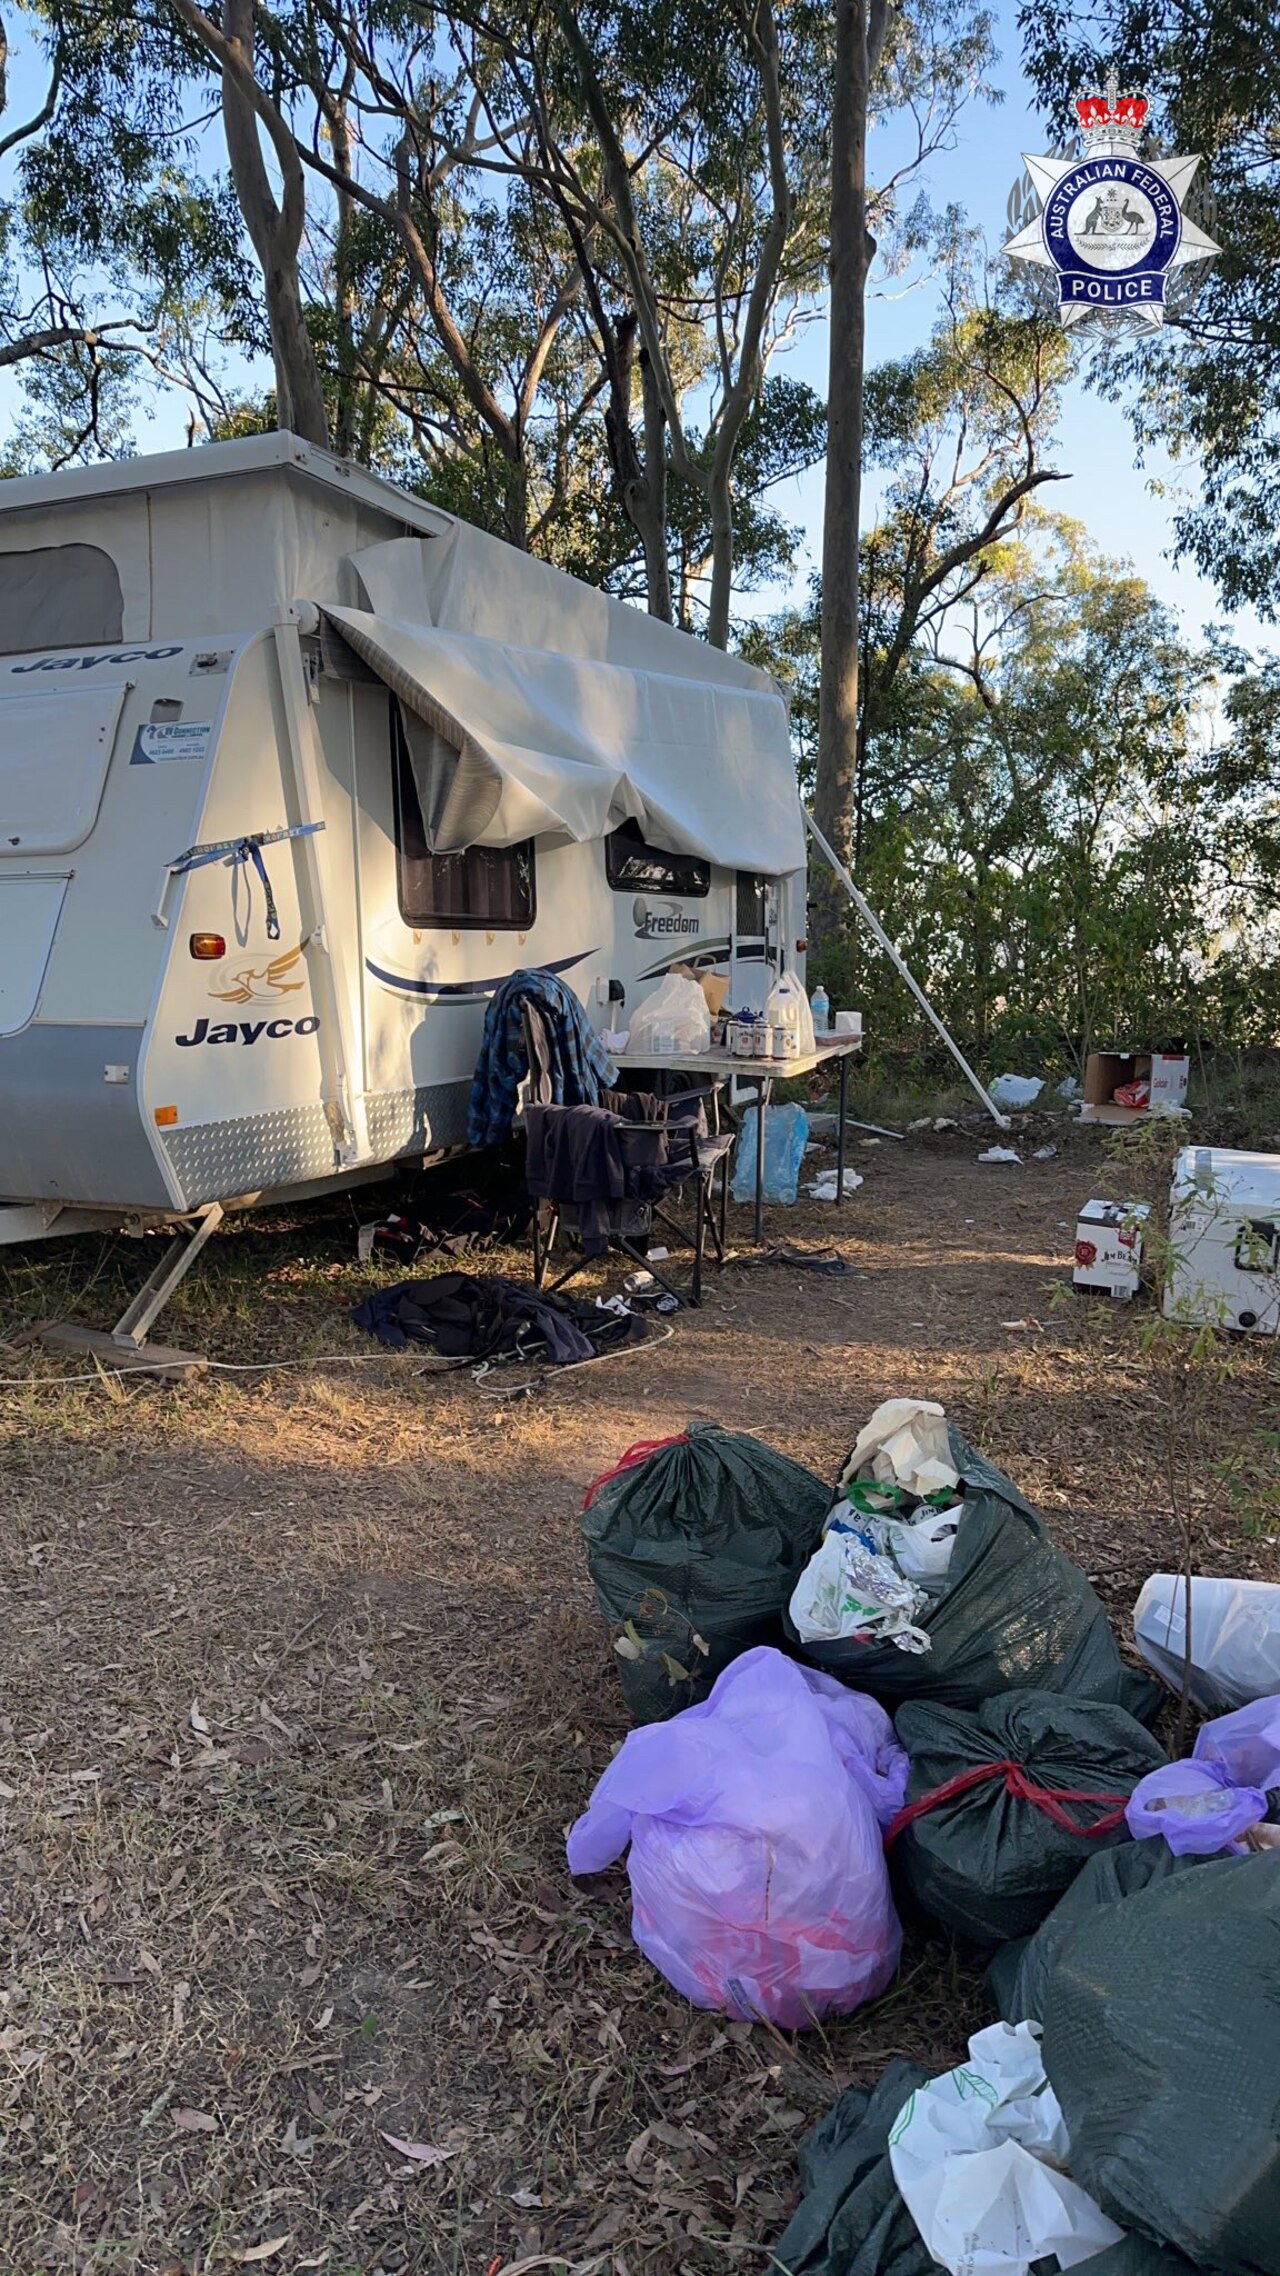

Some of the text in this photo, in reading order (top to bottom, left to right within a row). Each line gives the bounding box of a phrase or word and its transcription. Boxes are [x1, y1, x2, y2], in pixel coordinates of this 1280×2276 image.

[11, 646, 184, 673] Jayco
[645, 911, 699, 933] Freedom
[175, 1016, 320, 1047] Jayco
